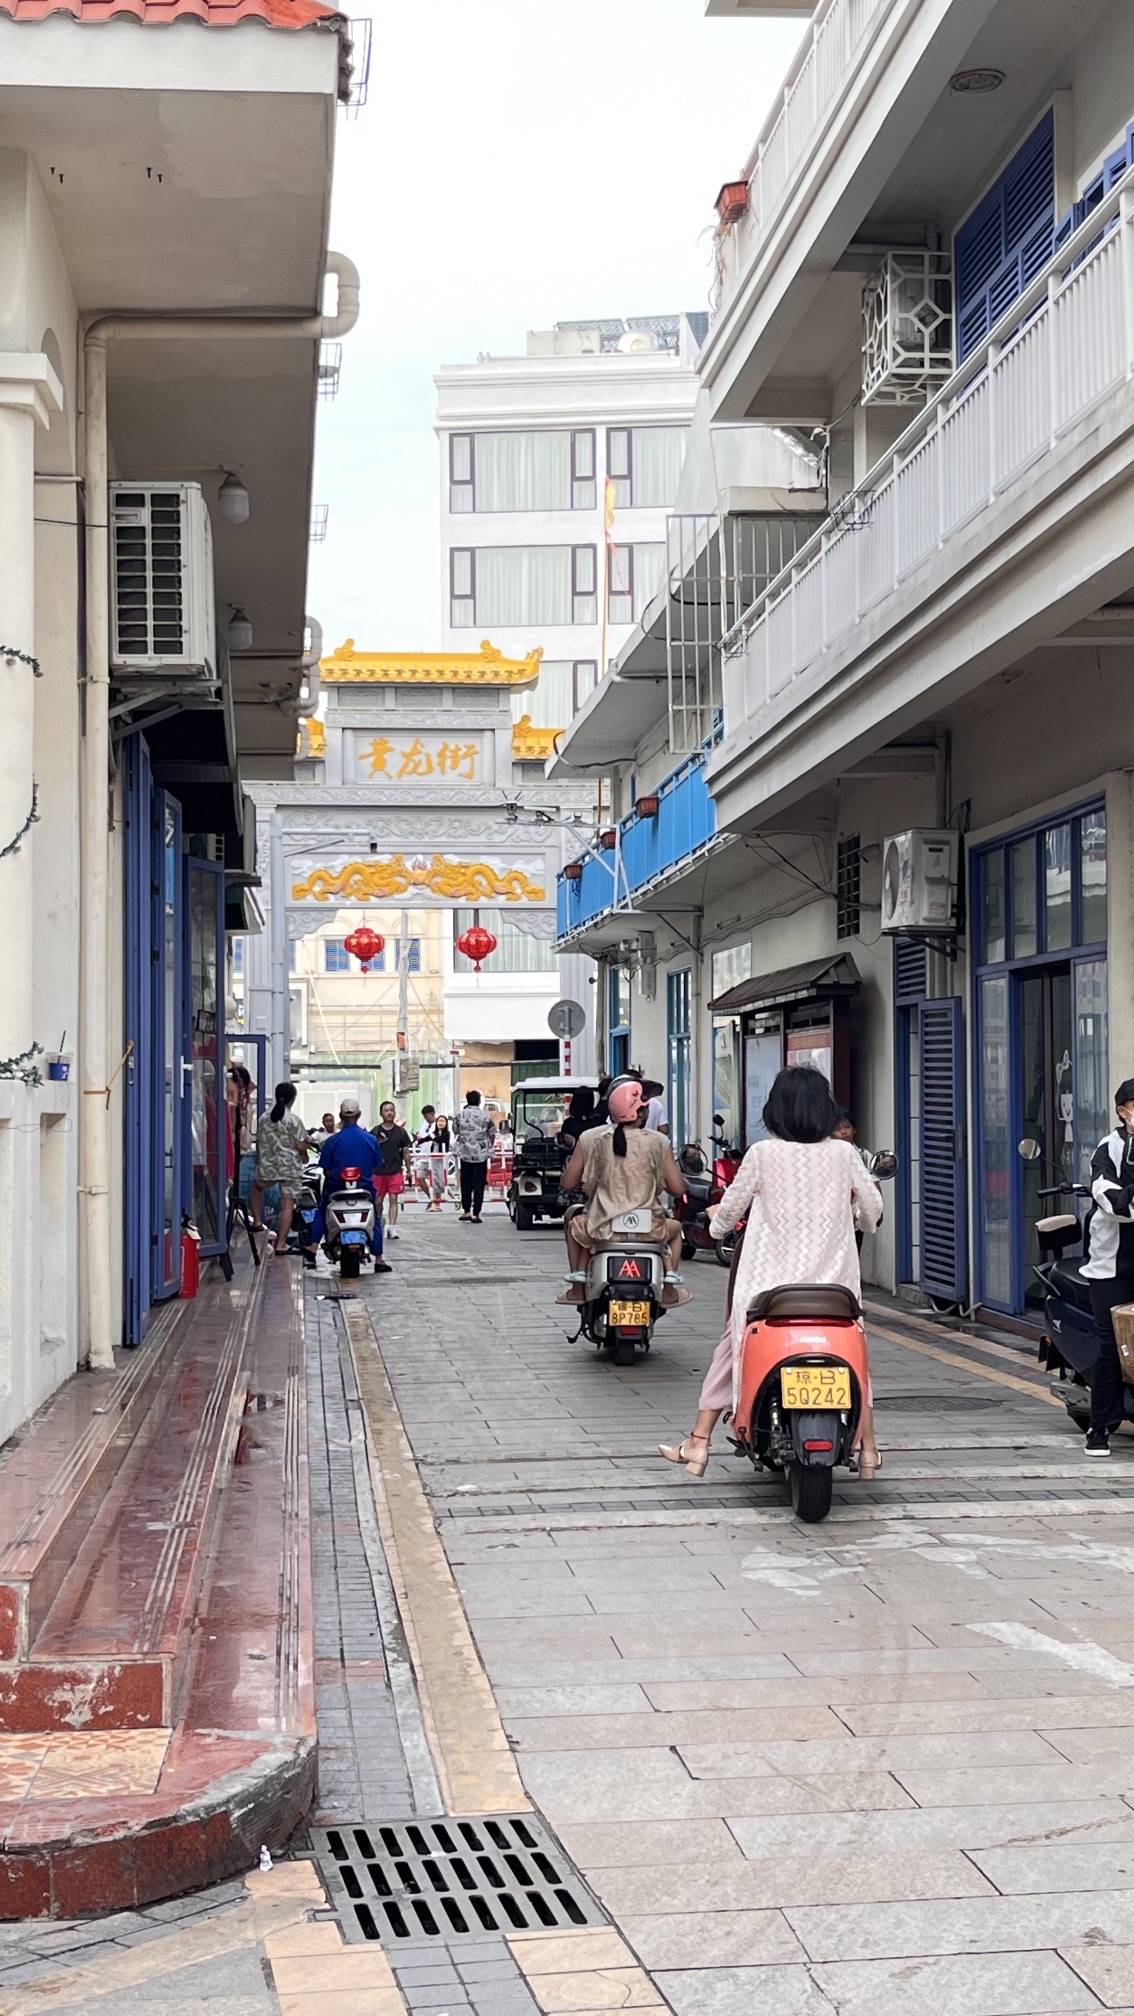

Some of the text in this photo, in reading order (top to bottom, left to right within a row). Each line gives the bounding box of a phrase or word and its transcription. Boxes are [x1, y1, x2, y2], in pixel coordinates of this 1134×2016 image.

[358, 737, 479, 780] 黄龙街
[787, 1387, 847, 1406] 5Q242
